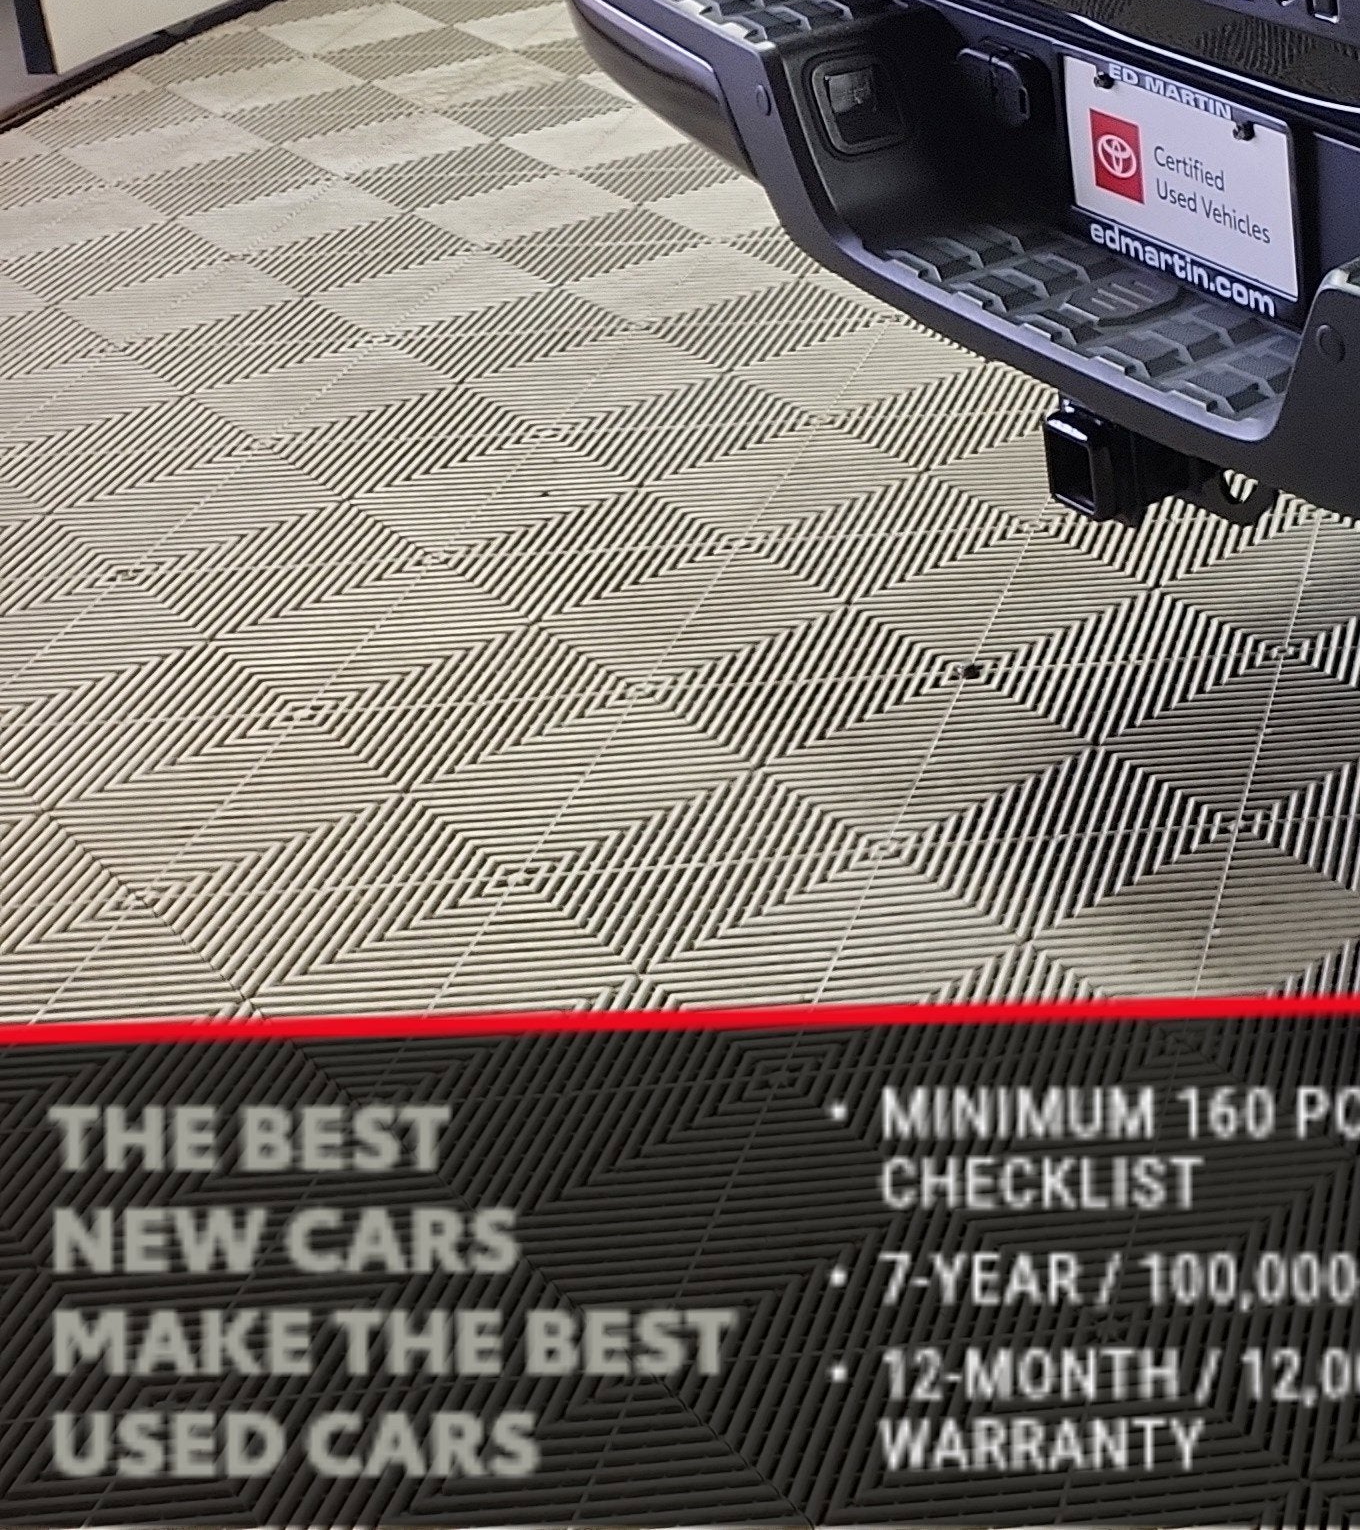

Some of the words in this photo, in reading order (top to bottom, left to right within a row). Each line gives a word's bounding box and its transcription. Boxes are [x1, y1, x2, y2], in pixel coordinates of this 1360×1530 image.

[1108, 63, 1138, 84] ED
[1145, 76, 1232, 119] MARTIN
[1153, 146, 1225, 191] Certified
[1156, 179, 1197, 213] Used
[1202, 193, 1271, 244] Vehicles
[1091, 222, 1275, 317] edmartin.com
